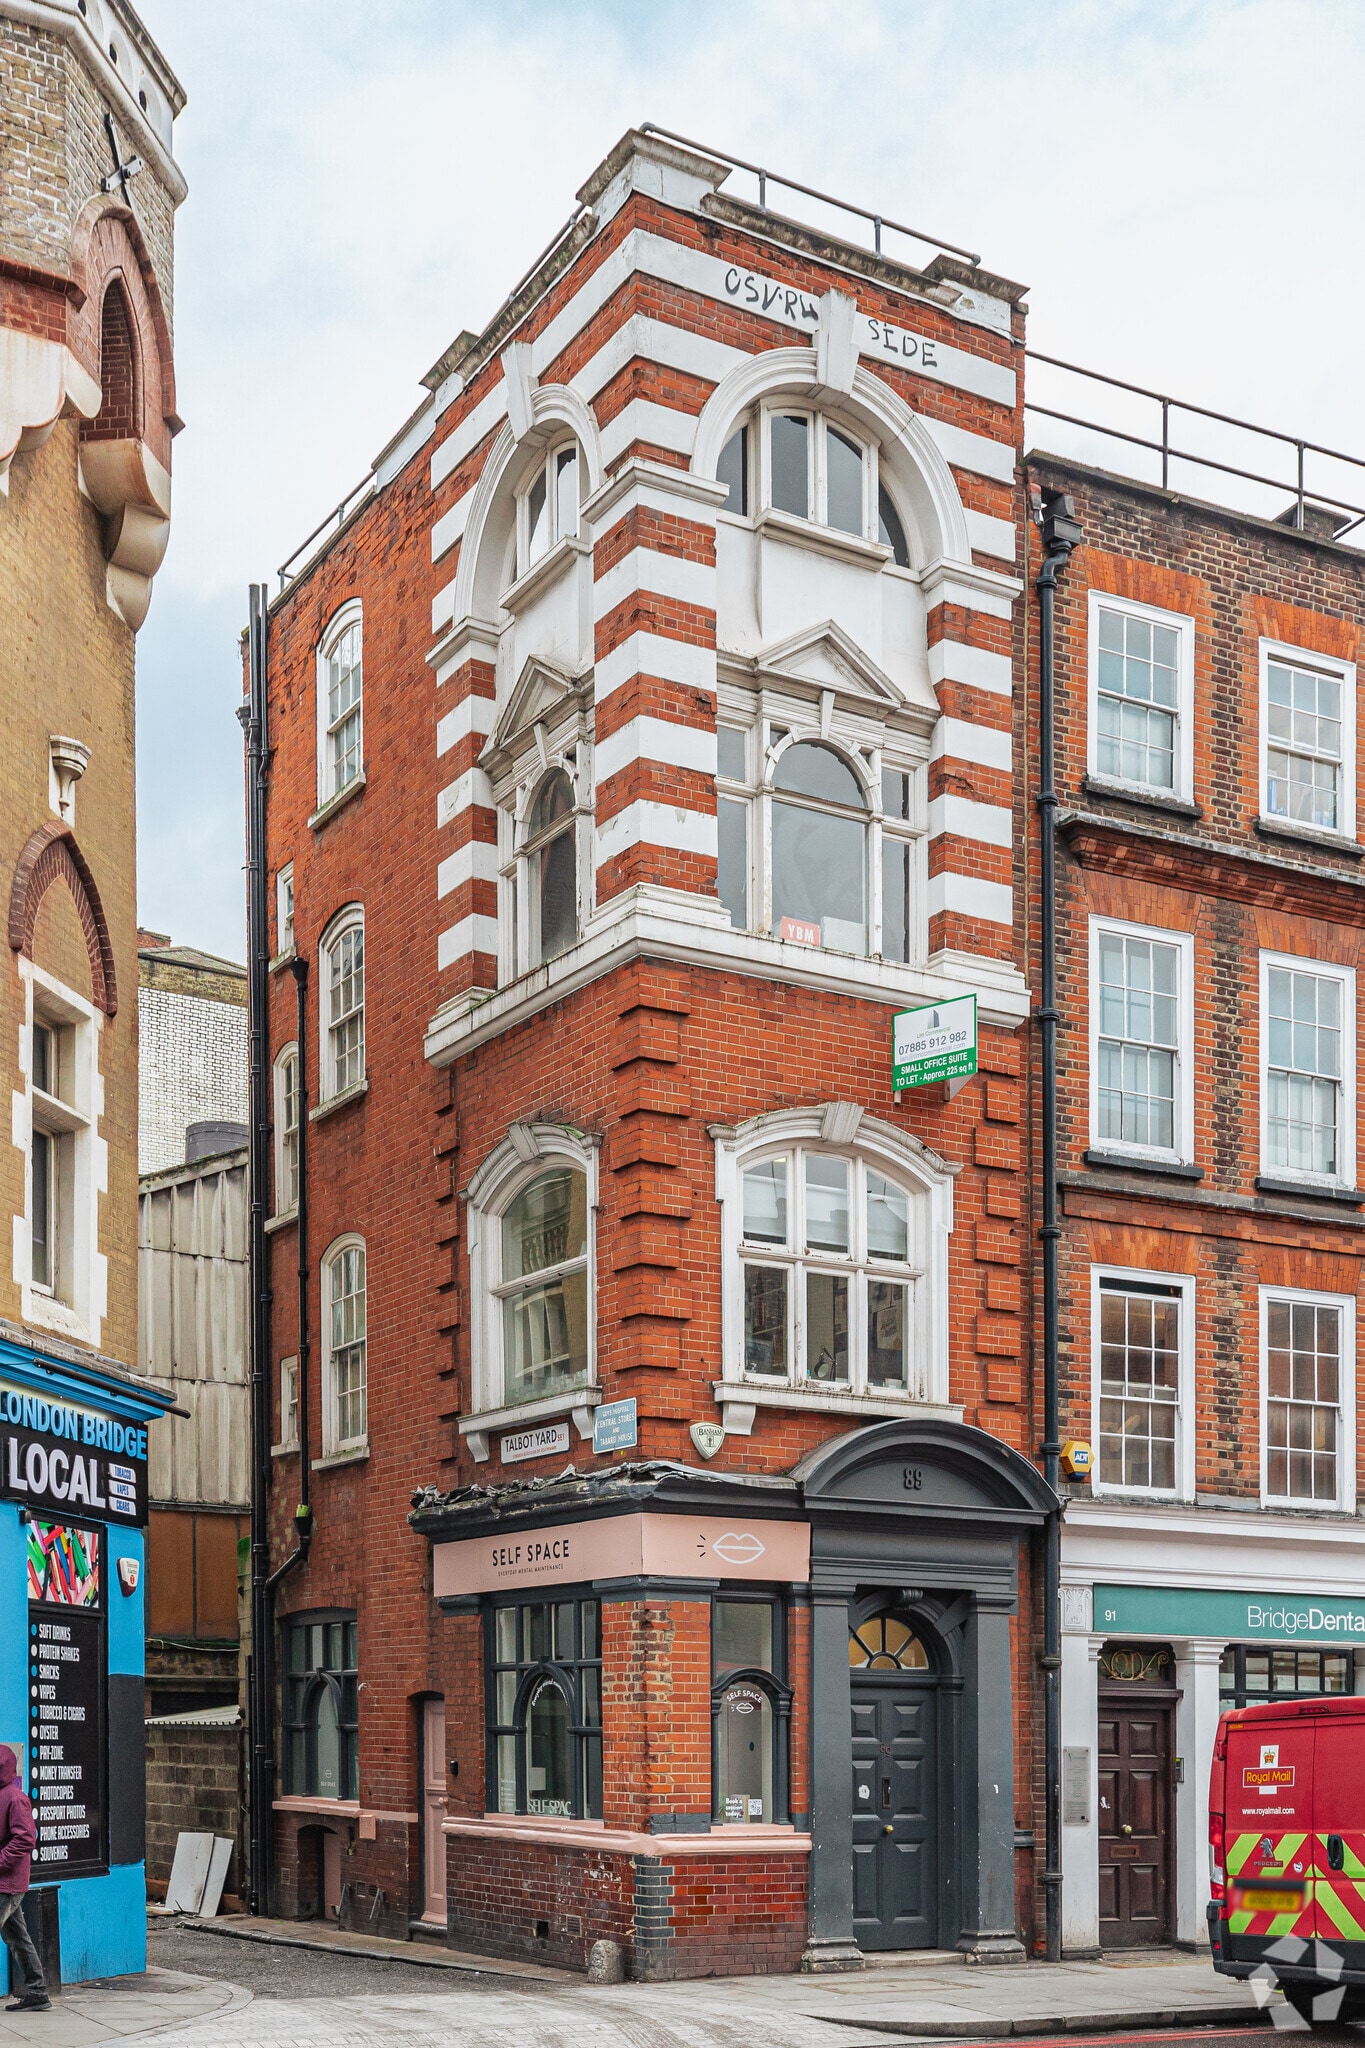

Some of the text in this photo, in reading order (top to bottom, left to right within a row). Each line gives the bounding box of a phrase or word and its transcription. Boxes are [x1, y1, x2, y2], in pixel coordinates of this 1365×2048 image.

[868, 319, 938, 367] SIDE
[787, 923, 815, 943] YBM
[898, 1030, 967, 1056] 07885 912 982
[901, 1052, 968, 1075] SMALL OFFICE SUITE
[896, 1078, 905, 1087] TO
[906, 1074, 919, 1084] LET
[922, 1070, 946, 1083] Approx
[947, 1065, 958, 1075] 225
[959, 1065, 967, 1074] sq
[967, 1062, 974, 1071] ft
[0, 1390, 147, 1461] LONDON BRIDGE
[598, 1413, 635, 1428] CENTRAL STORES
[505, 1433, 533, 1452] TALBOT
[535, 1429, 557, 1446] YARD
[619, 1432, 633, 1442] HOUSE
[1074, 1452, 1089, 1462] ADT
[9, 1436, 106, 1508] LOCAL
[904, 1468, 922, 1490] 89
[492, 1540, 570, 1567] SELF SPACE
[518, 1566, 533, 1574] MENTAL
[534, 1563, 564, 1572] MAINTENANCE
[1105, 1609, 1116, 1621] 91
[39, 1623, 71, 1641] SOFT DRINKS
[39, 1644, 80, 1662] PROTEIN SHAKES
[39, 1664, 60, 1680] SNACKS
[39, 1684, 56, 1700] VAPES
[726, 1690, 763, 1703] SELF SPACE
[39, 1704, 86, 1721] TOBACCO & CIGARS
[39, 1725, 59, 1740] OYSTER
[39, 1745, 64, 1760] PAY-ZONE
[39, 1765, 82, 1780] MONEY TRANSFER
[1246, 1770, 1291, 1784] Royal Mail
[39, 1785, 74, 1801] PHOTOCOPIES
[40, 1804, 86, 1821] PASSPORT PHOTOS
[528, 1799, 572, 1816] SELF SPAC
[1242, 1806, 1295, 1816] www.royalmail.com
[40, 1824, 90, 1841] PHONE ACCESSORIES
[40, 1845, 69, 1862] SOUVENIRS
